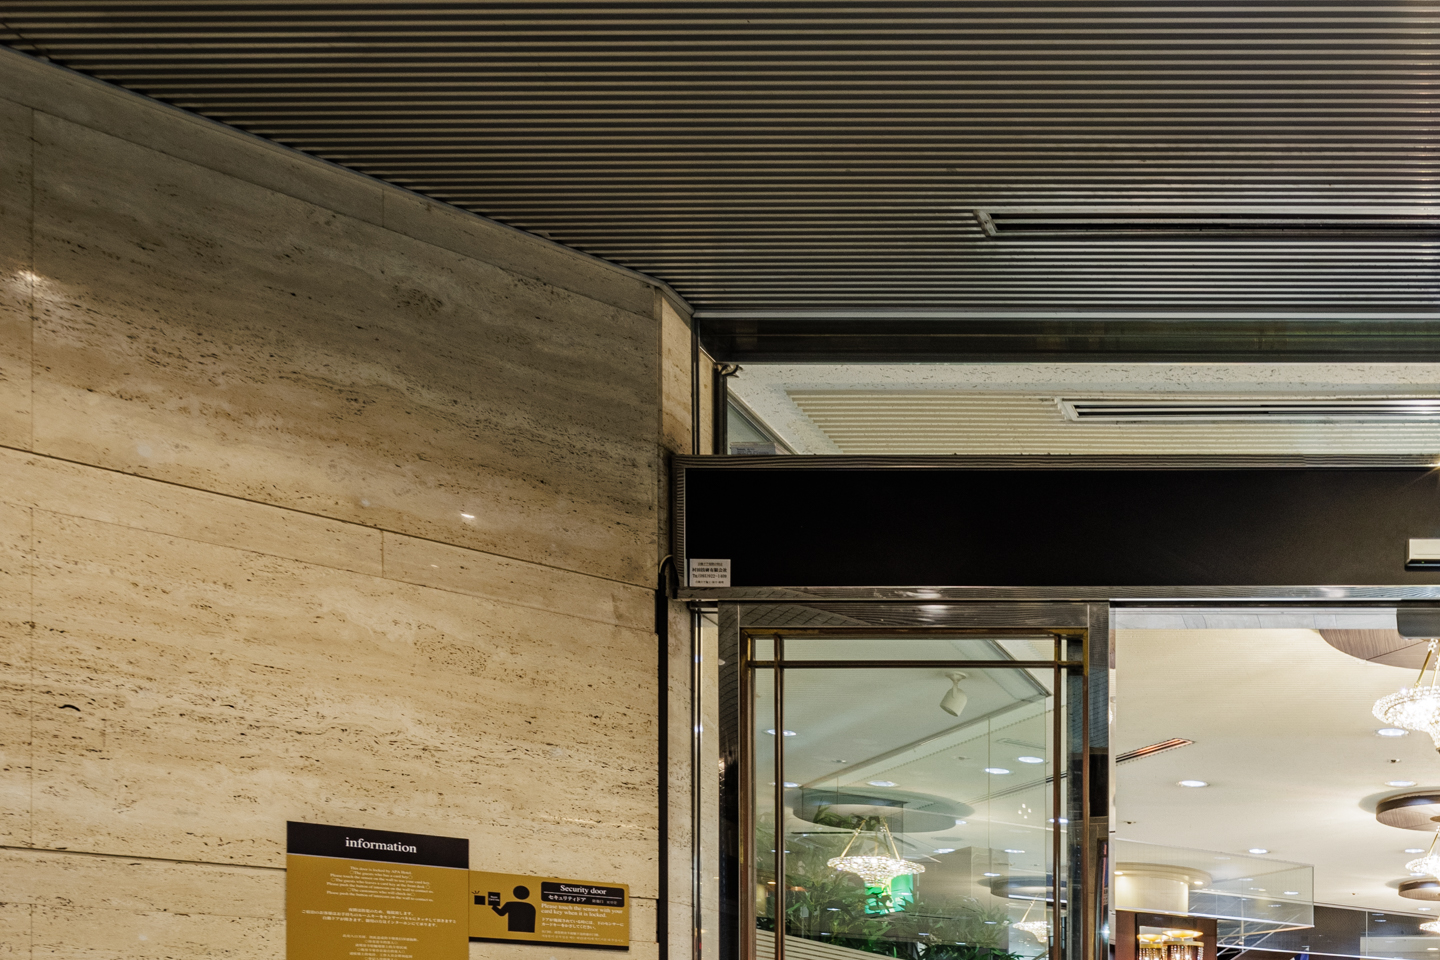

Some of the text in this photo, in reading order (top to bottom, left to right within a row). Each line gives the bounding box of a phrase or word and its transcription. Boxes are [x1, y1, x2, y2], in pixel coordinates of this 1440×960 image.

[345, 836, 417, 854] information
[560, 884, 607, 895] Security door
[548, 894, 587, 902] セキュリティドア
